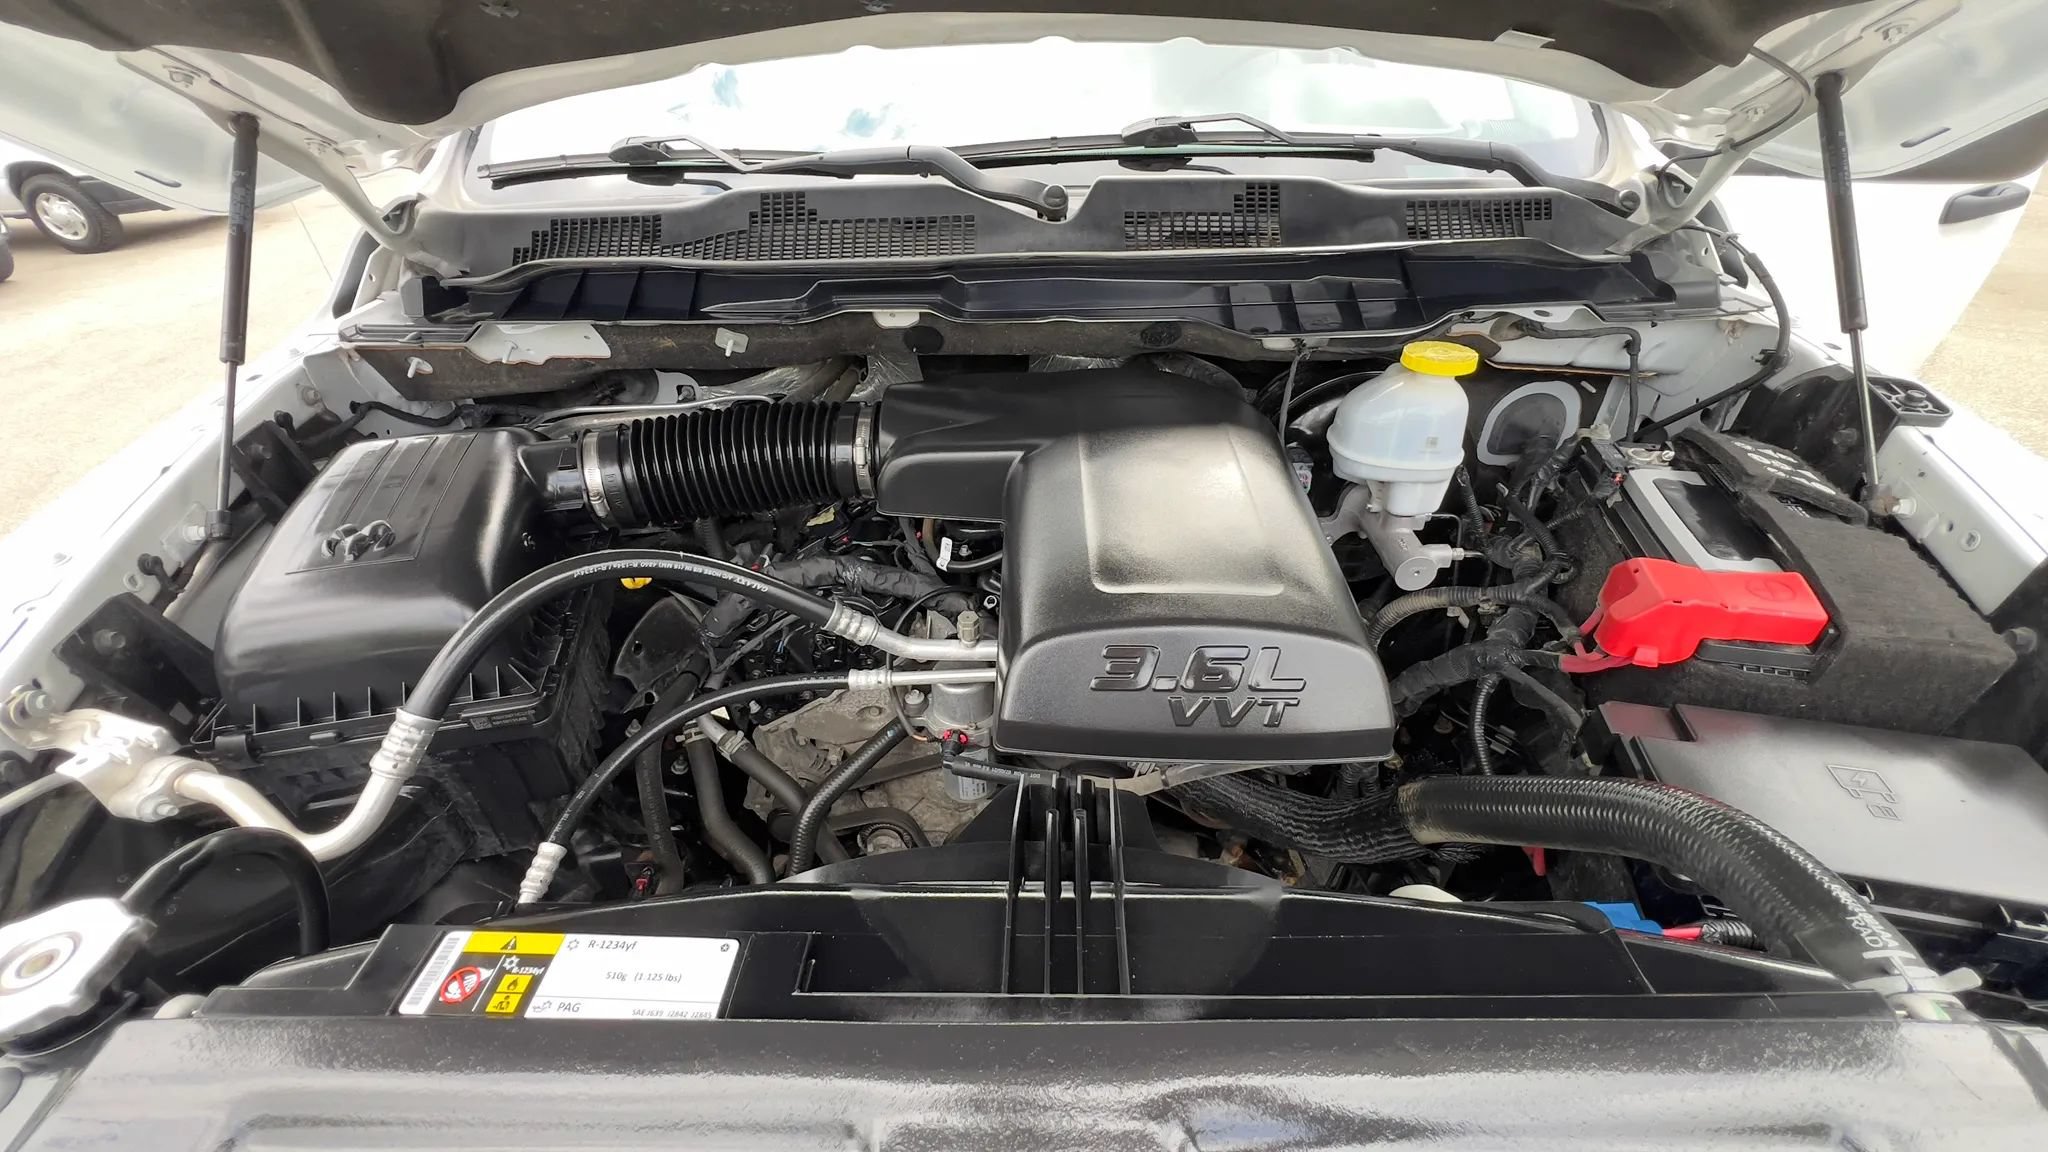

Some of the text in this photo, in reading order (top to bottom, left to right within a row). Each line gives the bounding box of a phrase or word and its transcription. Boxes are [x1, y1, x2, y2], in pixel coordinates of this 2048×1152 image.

[573, 565, 608, 578] R-1234yf
[703, 568, 722, 578] HOSE
[735, 576, 769, 593] GALAXY
[1089, 644, 1307, 692] 3.6L
[1168, 696, 1301, 727] VVT
[1845, 915, 1883, 948] RAD
[588, 939, 638, 952] R-1234yf
[605, 971, 628, 982] 510g
[665, 972, 682, 984] lbs)
[557, 1001, 581, 1013] PAG
[631, 1008, 646, 1017] SAE
